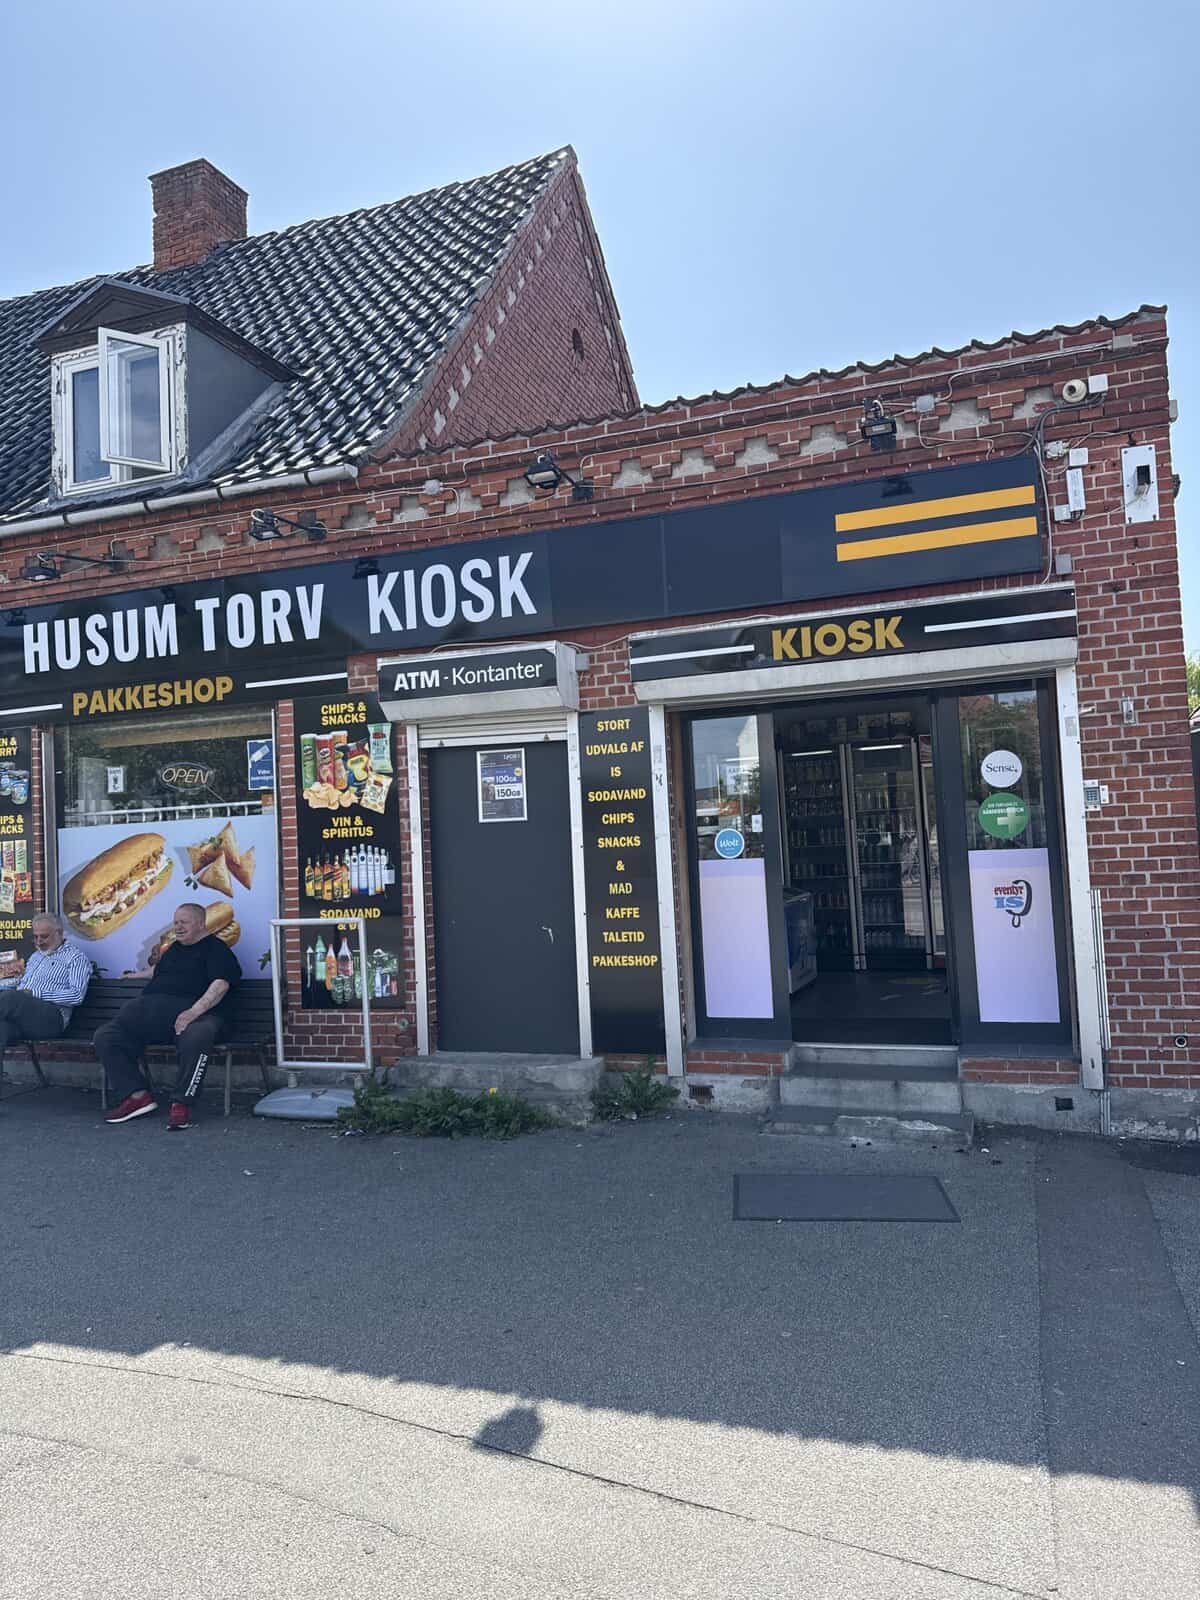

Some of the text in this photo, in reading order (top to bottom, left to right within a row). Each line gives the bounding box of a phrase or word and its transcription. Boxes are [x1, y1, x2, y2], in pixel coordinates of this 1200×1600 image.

[23, 552, 537, 674] HUSUM TORV KIOSK
[771, 616, 905, 661] KIOSK
[394, 669, 440, 692] ATM
[452, 662, 544, 686] Kontanter
[72, 676, 234, 716] PAKKESHOP
[321, 701, 367, 715] CHIPS &
[321, 712, 366, 726] SNACKS
[597, 719, 631, 732] STORT
[10, 736, 17, 746] &
[586, 741, 645, 756] UDVALG AF
[162, 767, 209, 784] OPEN
[610, 766, 621, 777] IS
[588, 788, 646, 802] SODAVAND
[16, 814, 24, 824] &
[331, 815, 363, 827] VIN &
[602, 812, 635, 825] CHIPS
[322, 826, 374, 839] SPIRITUS
[597, 836, 641, 848] SNACKS
[616, 860, 625, 871] &
[609, 882, 633, 895] MAD
[994, 896, 1024, 908] IS
[320, 908, 381, 919] SODAVAND
[606, 907, 641, 919] KAFFE
[5, 930, 24, 940] SLIK
[602, 931, 645, 943] TALETID
[592, 955, 658, 967] PAKKESHOP
